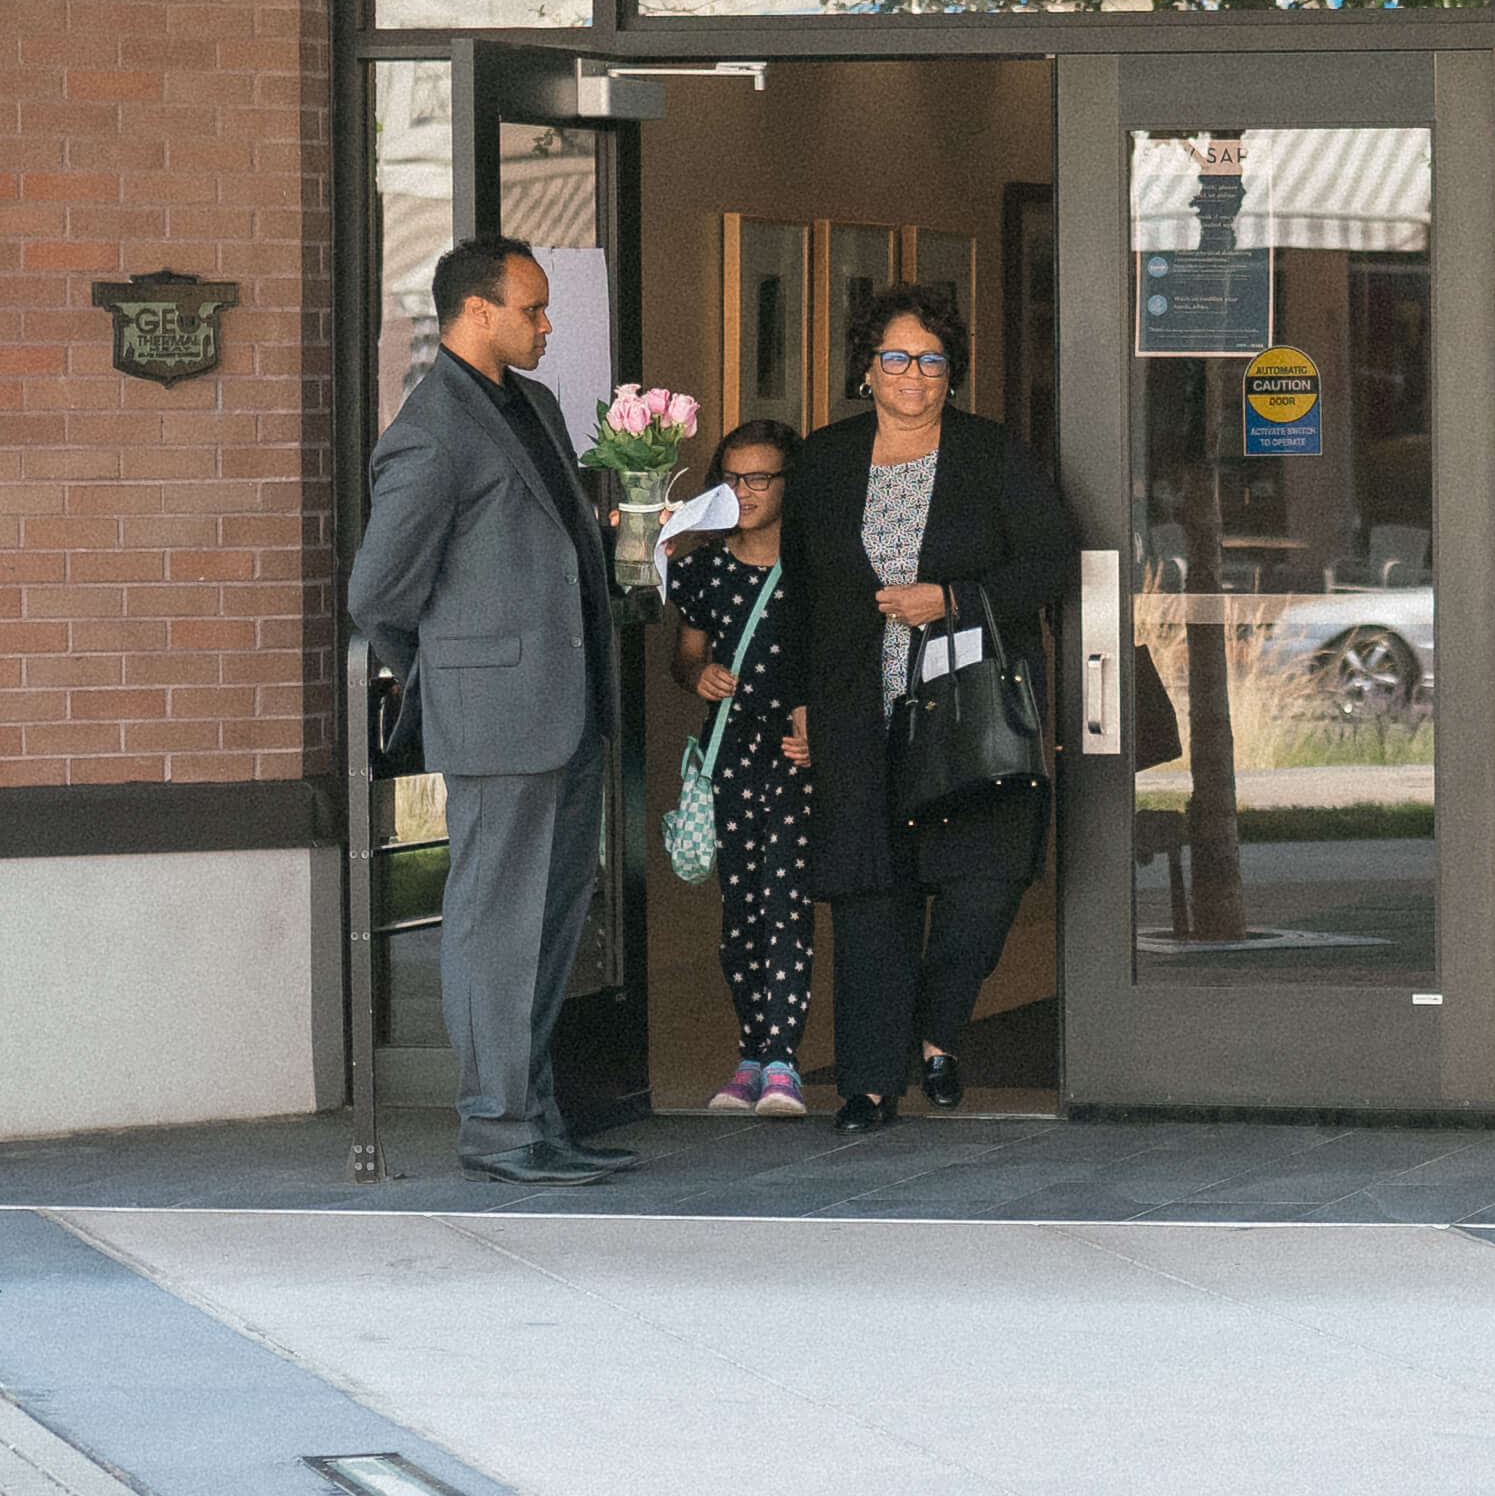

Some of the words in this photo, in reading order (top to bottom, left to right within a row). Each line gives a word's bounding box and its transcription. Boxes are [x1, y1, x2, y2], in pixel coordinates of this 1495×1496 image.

[1255, 366, 1308, 375] AUTOMATIC
[1252, 379, 1311, 392] CAUTION
[1269, 397, 1296, 406] DOOR
[1259, 438, 1271, 447] TO
